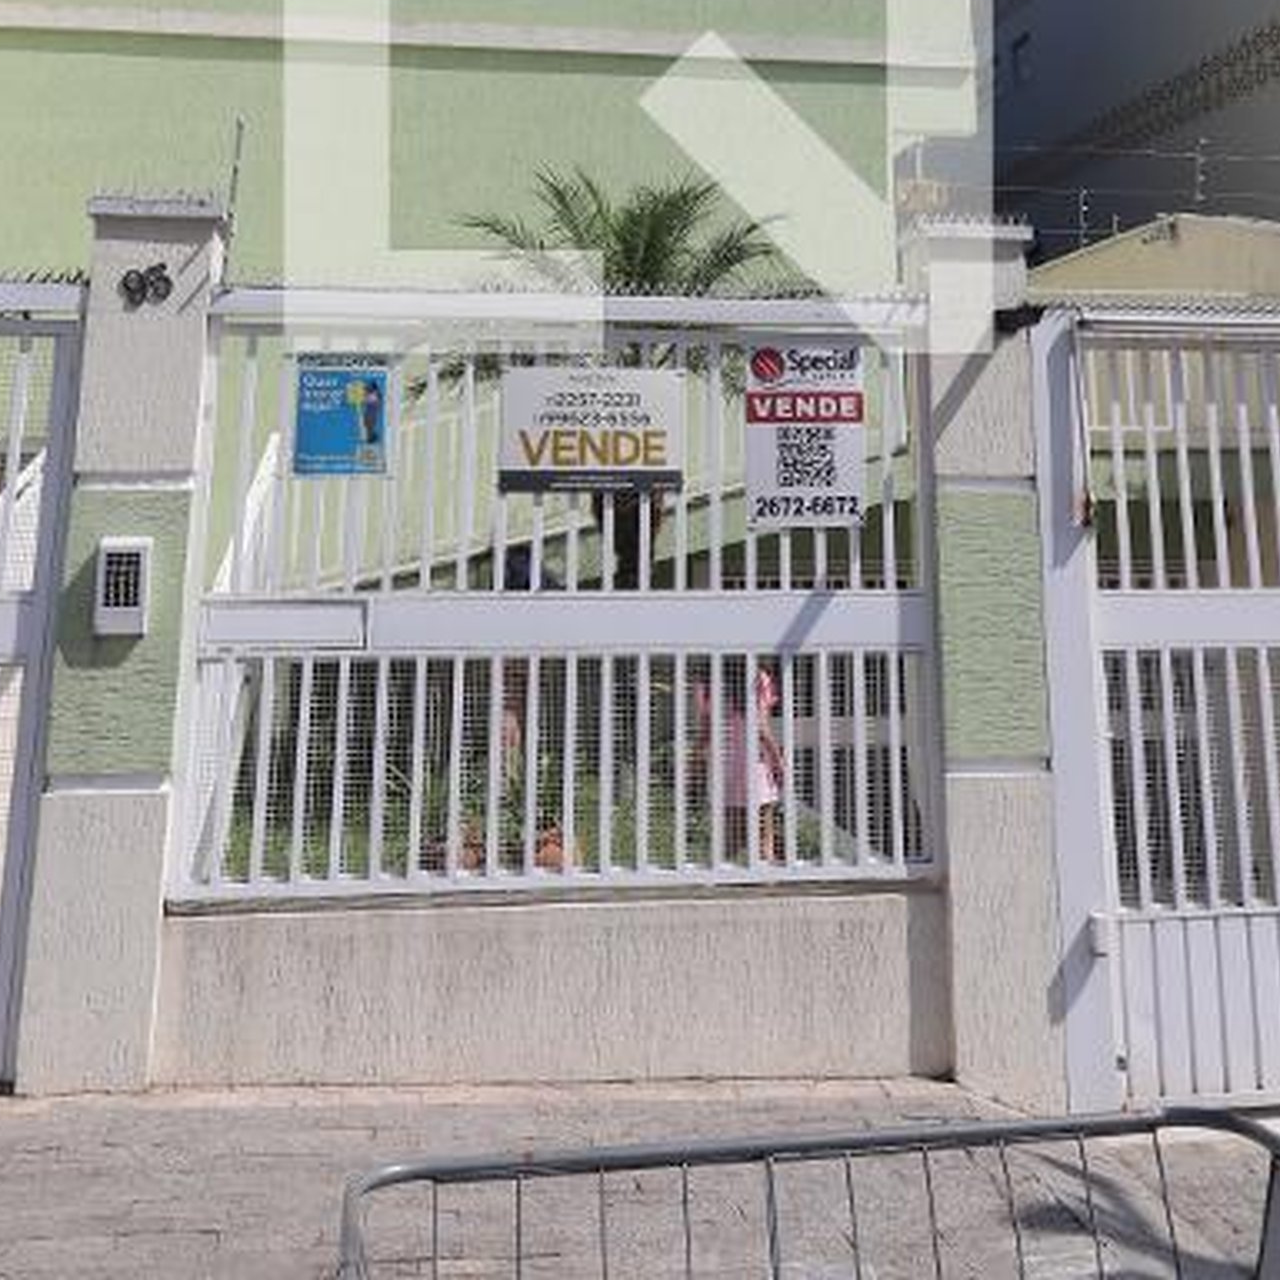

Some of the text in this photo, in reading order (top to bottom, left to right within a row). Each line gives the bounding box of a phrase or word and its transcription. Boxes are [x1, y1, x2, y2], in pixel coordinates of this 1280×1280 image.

[787, 347, 858, 375] Special
[753, 396, 857, 418] VENDE
[519, 430, 666, 466] VENDE
[756, 496, 858, 518] 2672-6672
